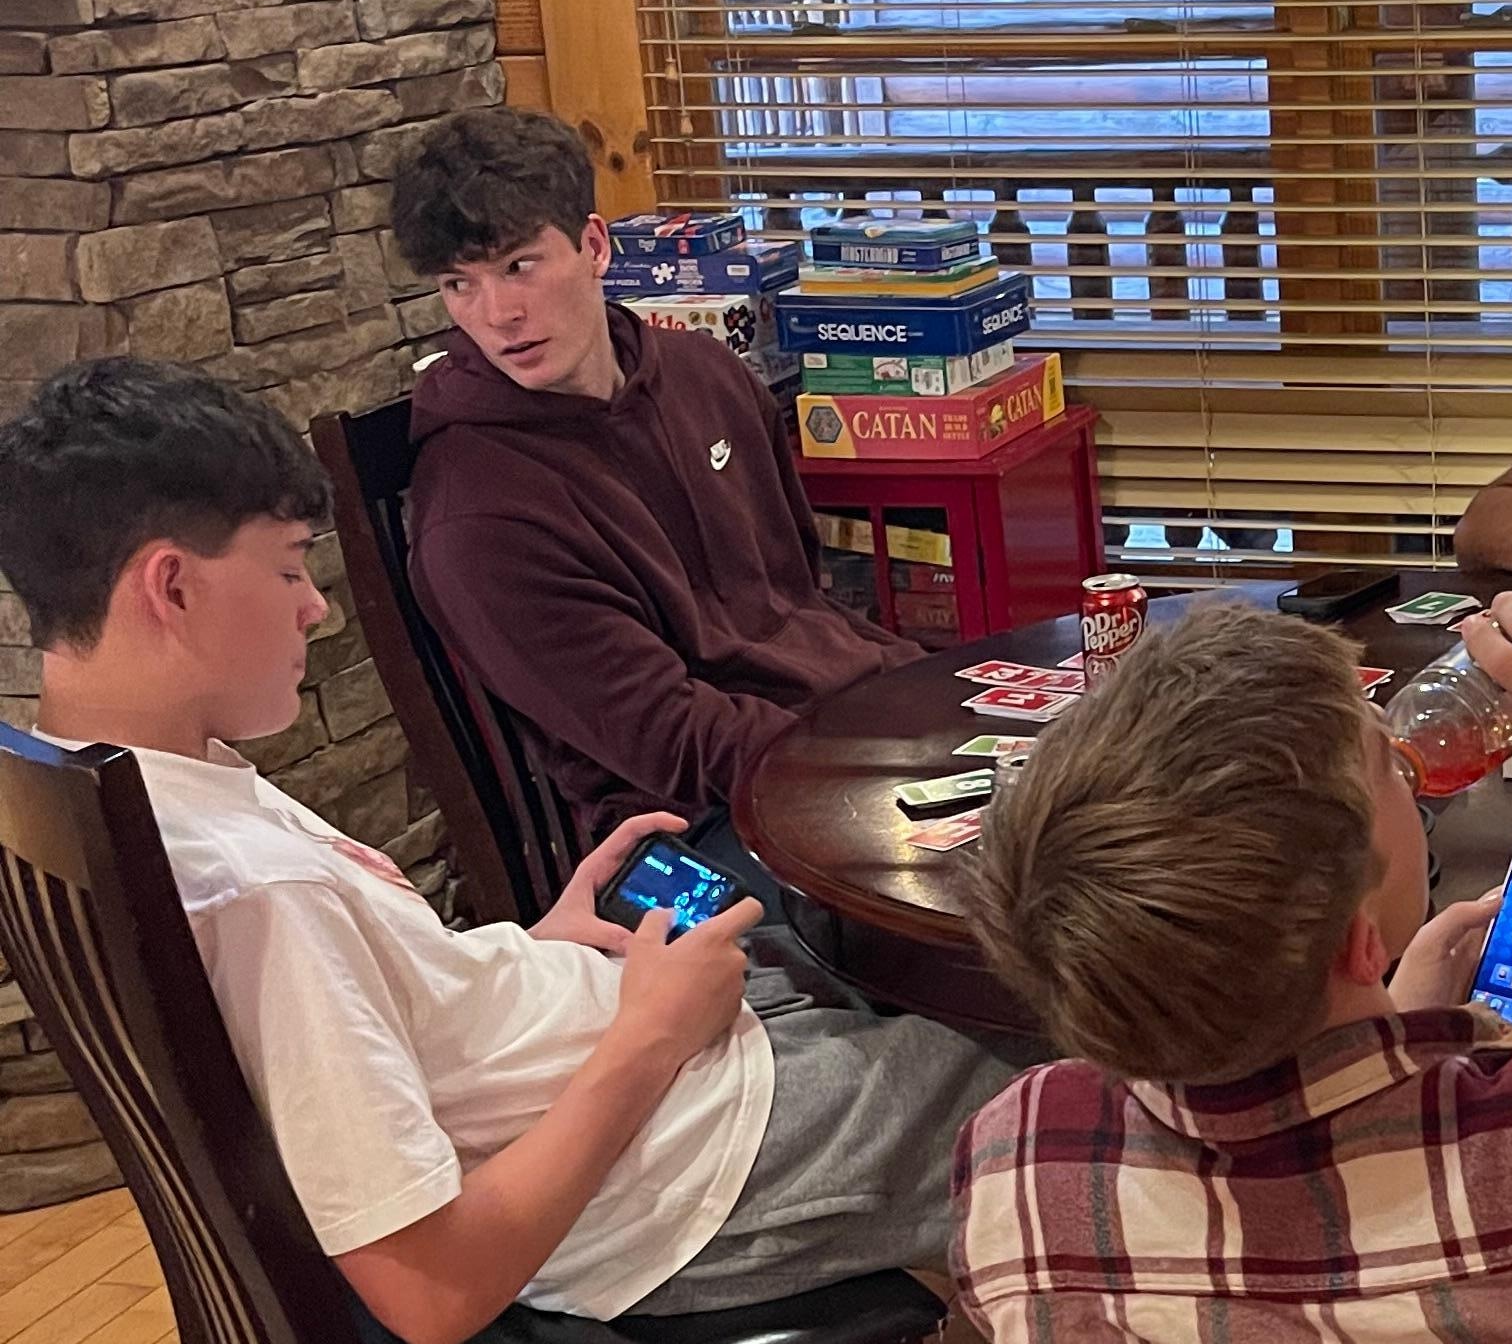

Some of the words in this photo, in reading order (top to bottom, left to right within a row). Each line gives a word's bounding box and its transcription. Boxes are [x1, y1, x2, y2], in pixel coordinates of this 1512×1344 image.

[817, 323, 908, 343] SEQUENCE
[982, 303, 1024, 335] SEQUENCE
[1006, 383, 1043, 423] CATAN
[852, 410, 938, 441] CATAN
[1080, 616, 1138, 653] Pepper
[1094, 612, 1122, 634] Dr
